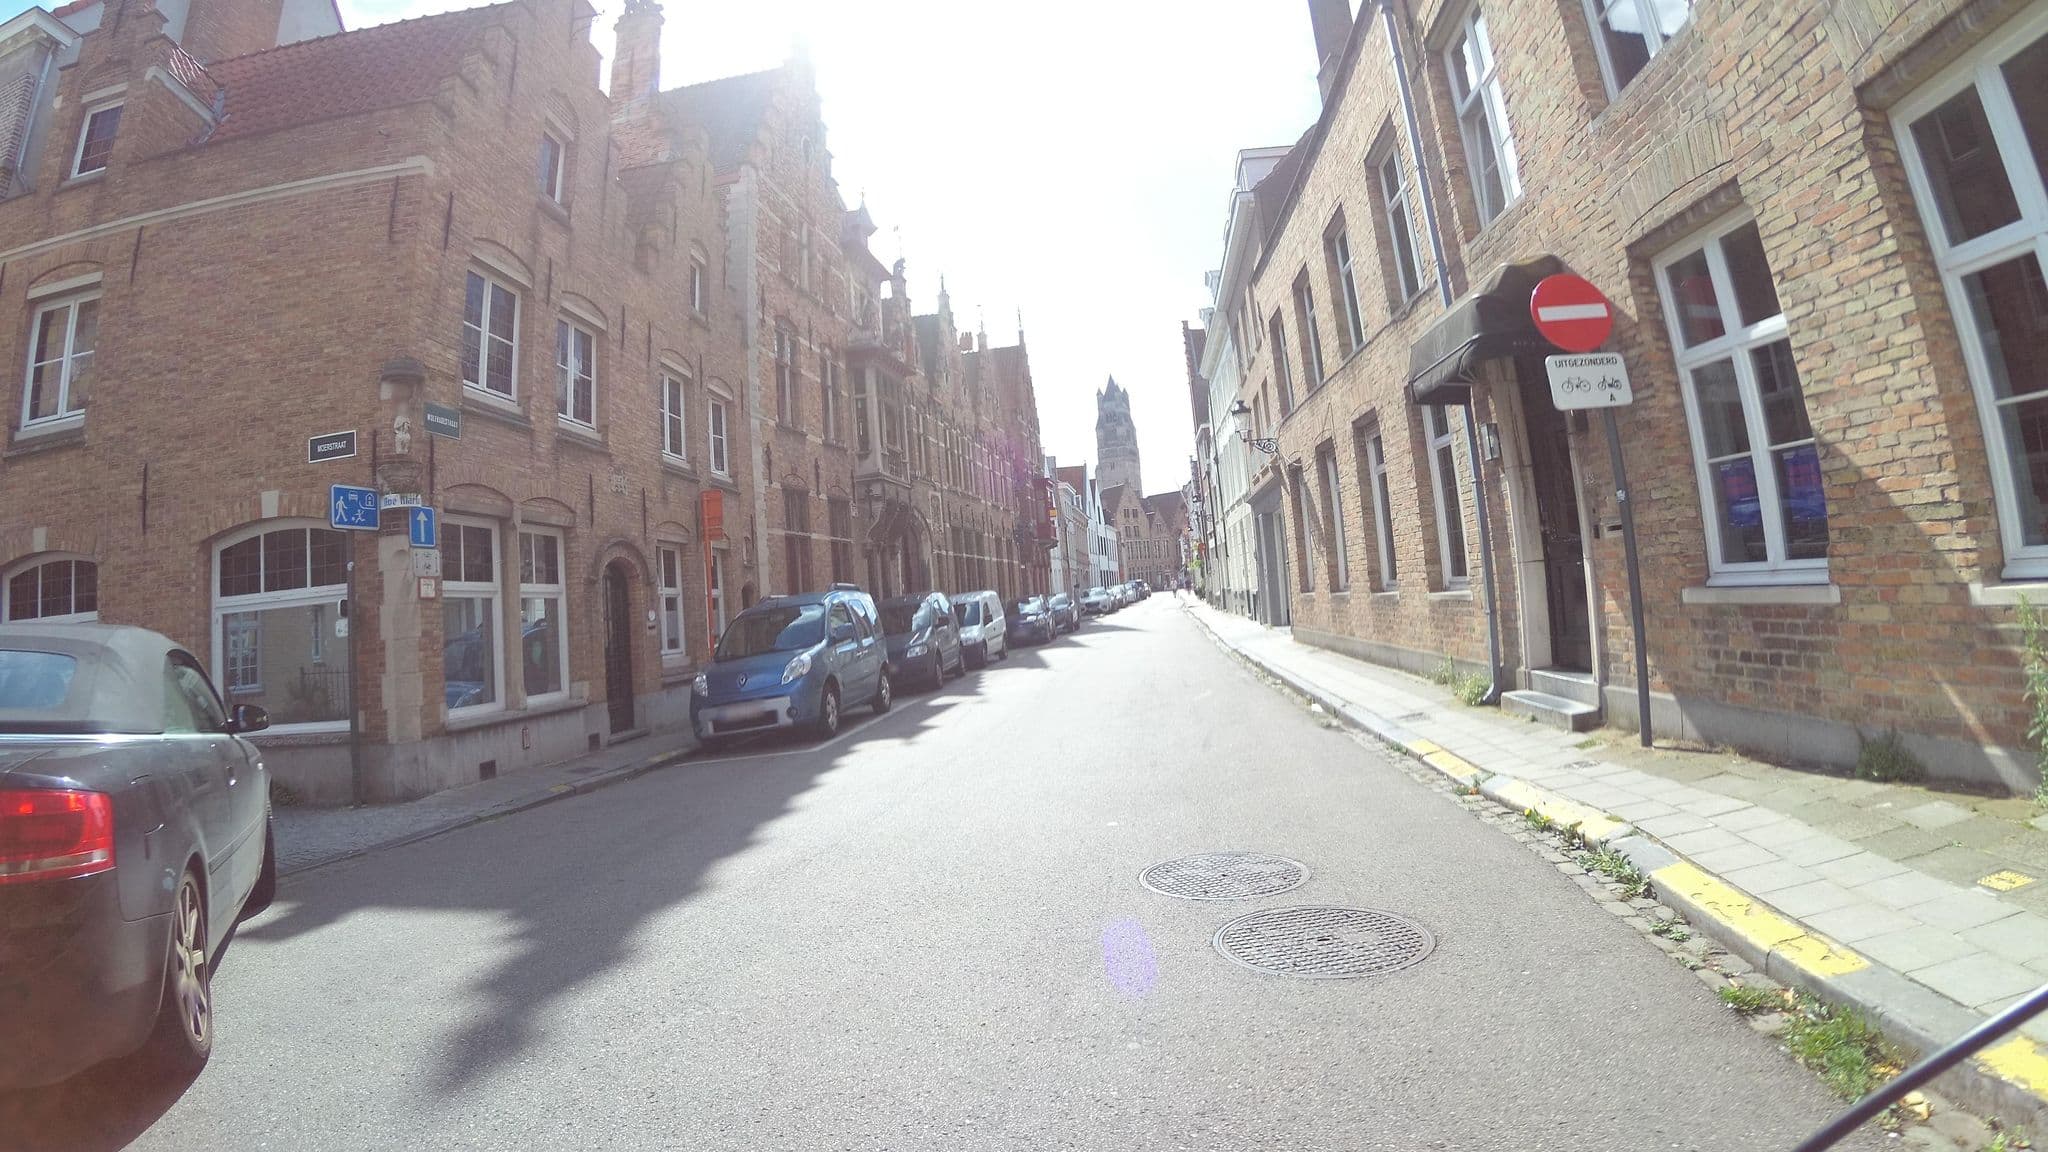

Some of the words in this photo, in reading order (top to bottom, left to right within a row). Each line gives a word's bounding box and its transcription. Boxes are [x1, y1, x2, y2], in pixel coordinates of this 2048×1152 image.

[1554, 357, 1617, 368] UITGEZONDERD
[1610, 392, 1616, 401] A
[318, 441, 346, 452] MOERSTRAAT
